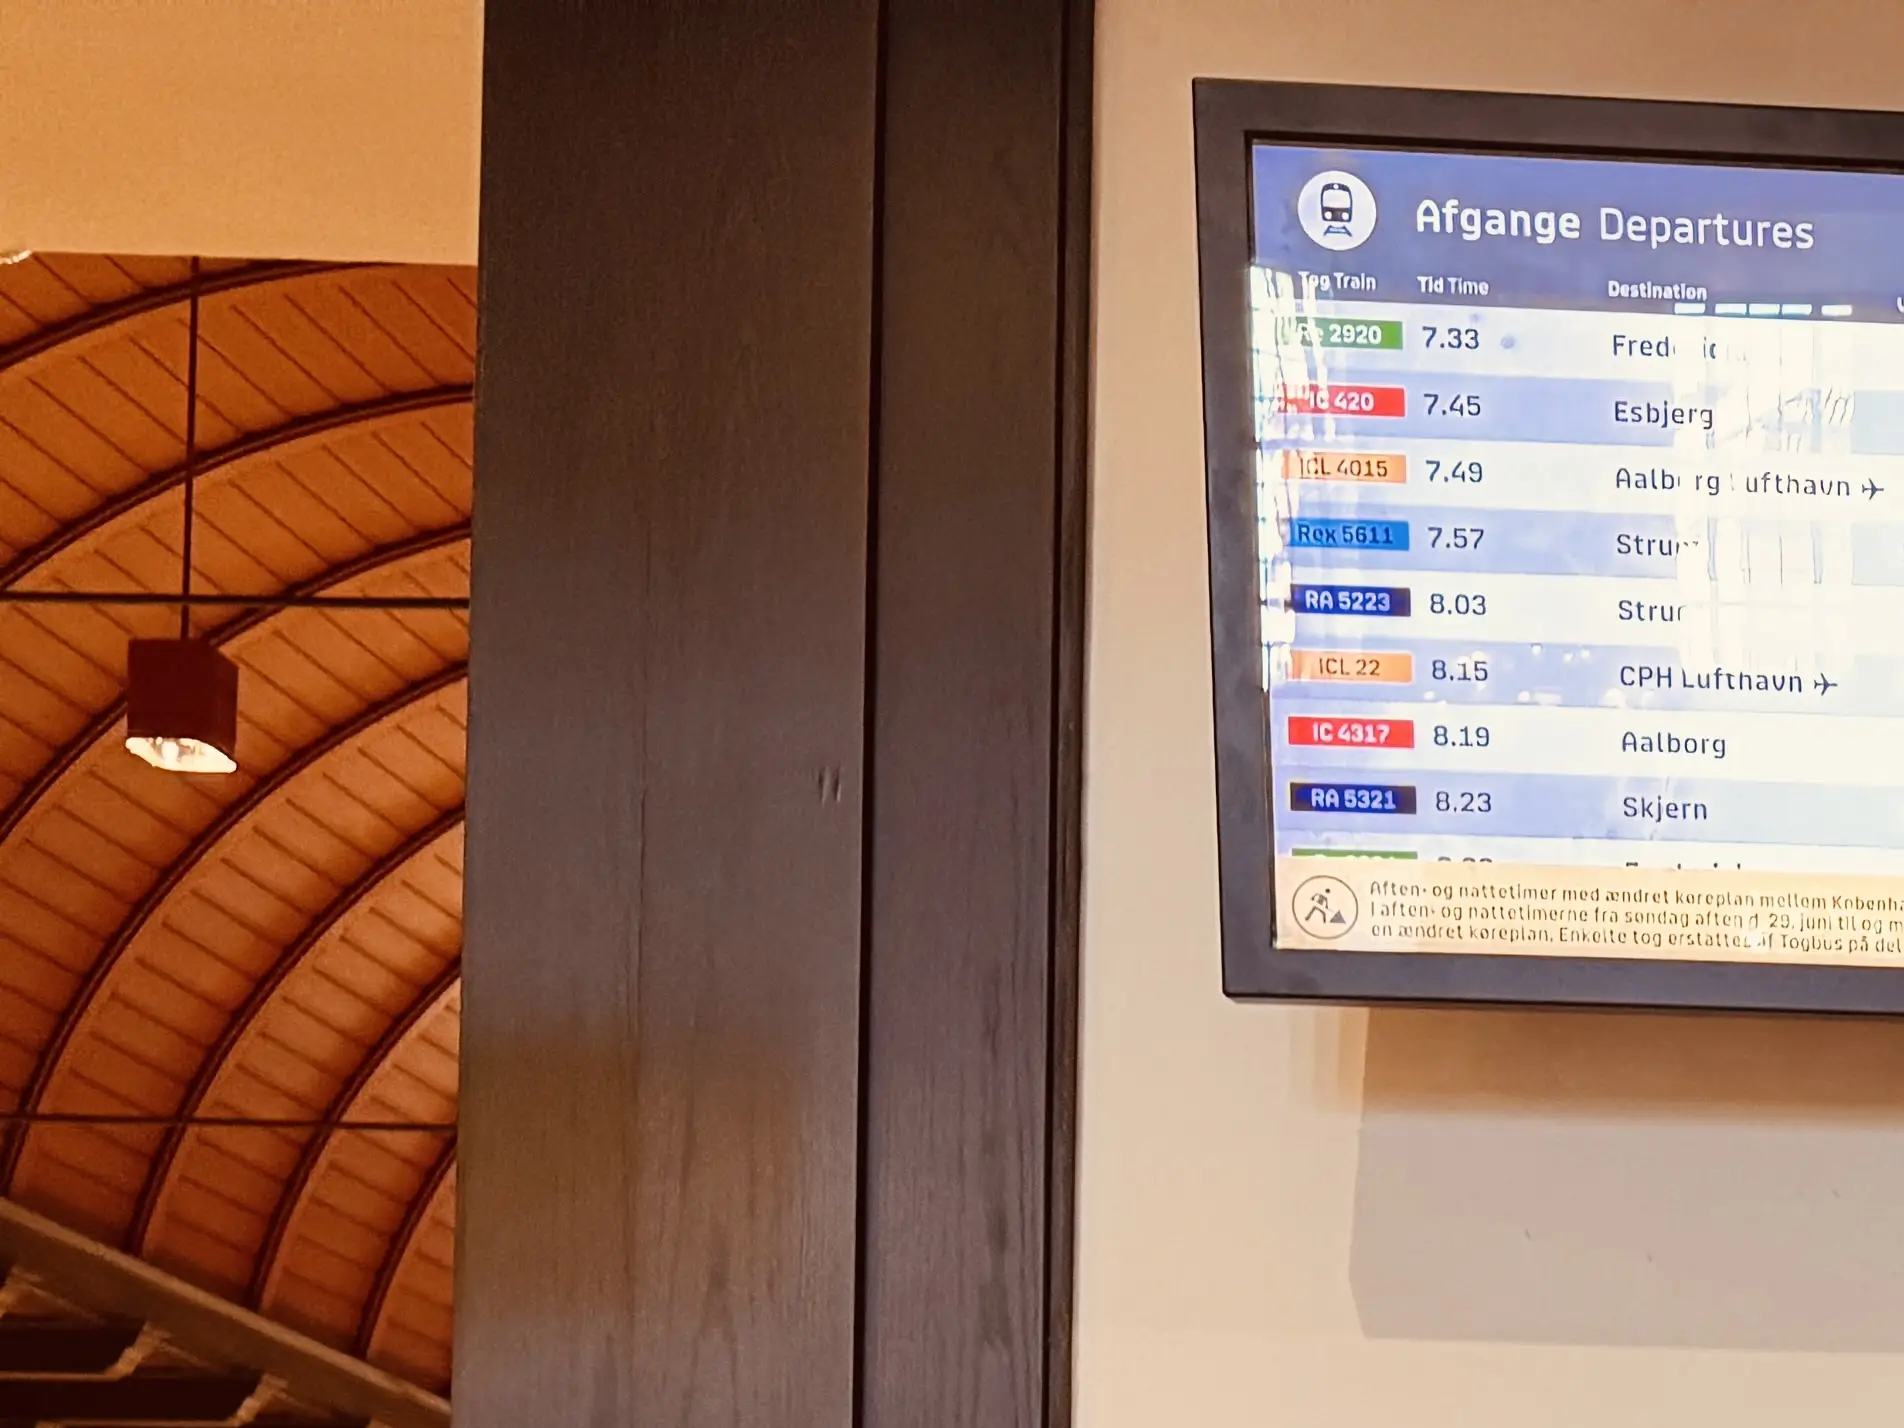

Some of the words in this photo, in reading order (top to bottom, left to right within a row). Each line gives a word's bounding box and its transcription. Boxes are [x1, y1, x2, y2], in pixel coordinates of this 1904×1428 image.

[1417, 199, 1580, 243] Afgange
[1601, 208, 1813, 249] Departures
[1608, 280, 1707, 301] Destination
[1423, 326, 1479, 349] 7.33
[1424, 394, 1480, 416] 7.45
[1615, 400, 1712, 429] Esbjerg
[1426, 460, 1482, 482] 7.49
[1428, 527, 1484, 549] 7.57
[1305, 591, 1334, 610] RA
[1338, 591, 1389, 611] 5223
[1431, 594, 1486, 615] 8.03
[1318, 658, 1349, 677] ICL
[1353, 658, 1380, 678] 22
[1432, 660, 1488, 681] 8.15
[1621, 666, 1671, 688] CPH
[1682, 668, 1801, 692] Lufthavn
[1312, 722, 1333, 742] IC
[1338, 723, 1389, 744] 4317
[1434, 726, 1489, 746] 8.19
[1623, 732, 1725, 758] Aalborg
[1311, 788, 1338, 808] RA
[1343, 789, 1396, 809] 5321
[1436, 792, 1491, 812] 8.23
[1624, 796, 1706, 822] Skjern
